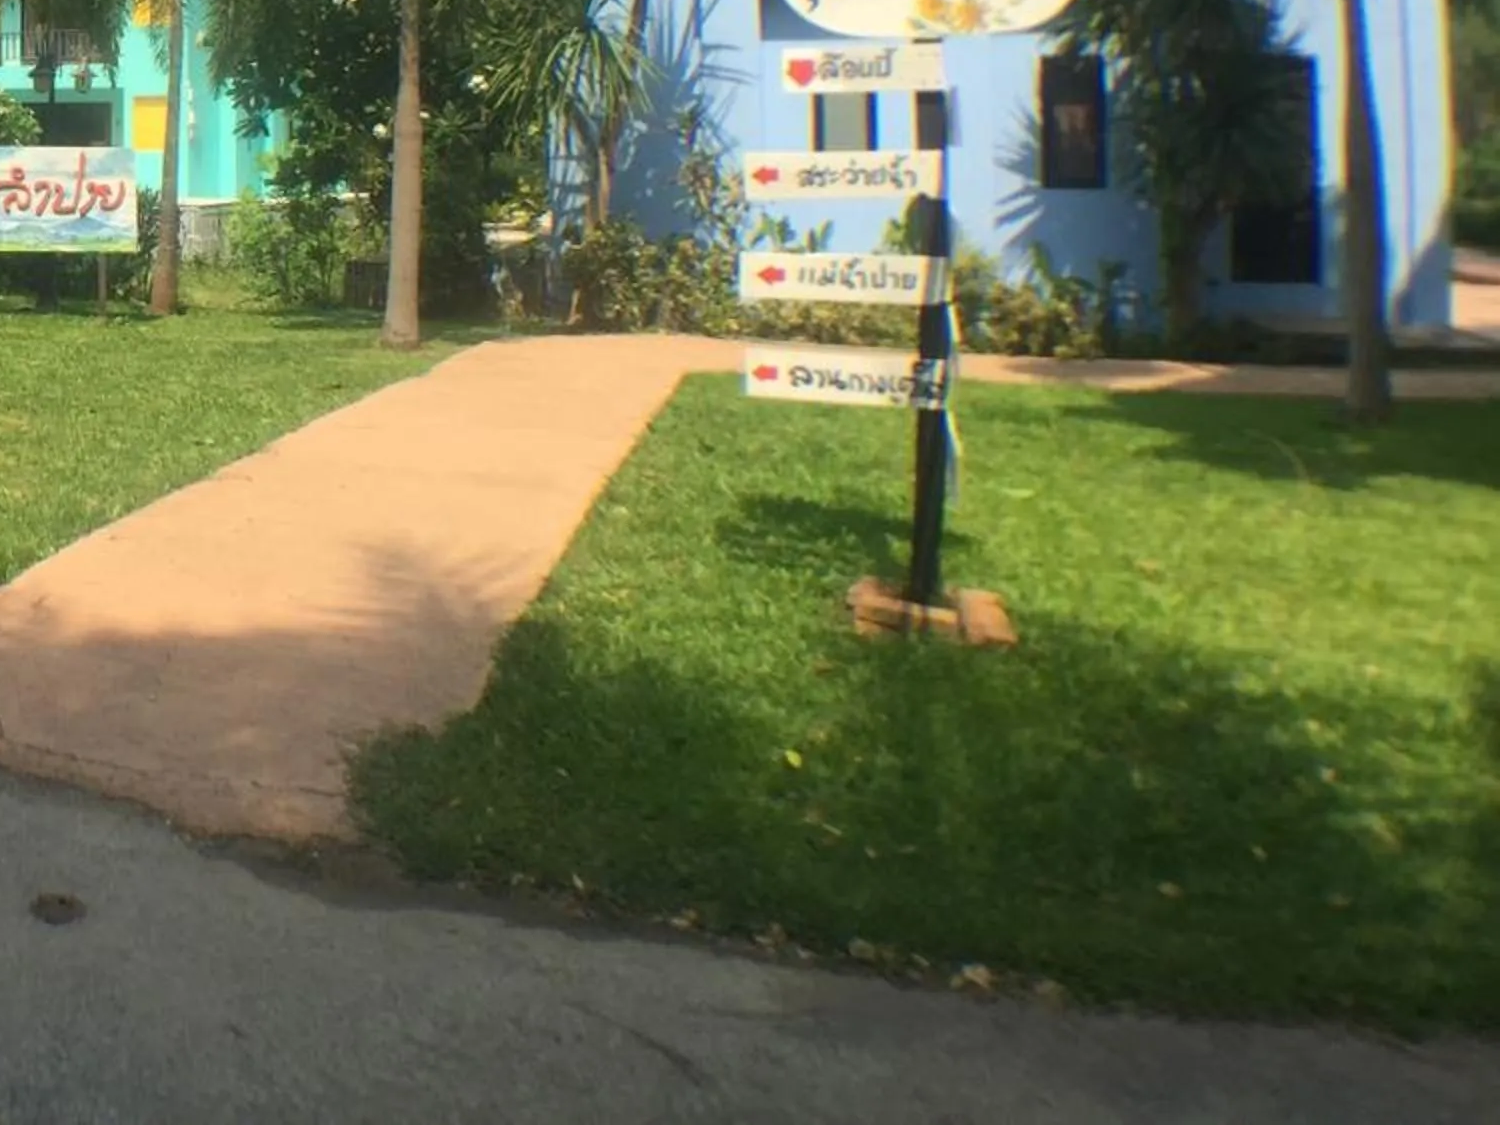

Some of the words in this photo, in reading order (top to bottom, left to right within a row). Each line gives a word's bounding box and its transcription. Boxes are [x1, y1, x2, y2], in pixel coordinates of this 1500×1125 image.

[797, 154, 918, 189] สระว่ายน้ำ
[797, 257, 918, 291] แม่น้ำปาย
